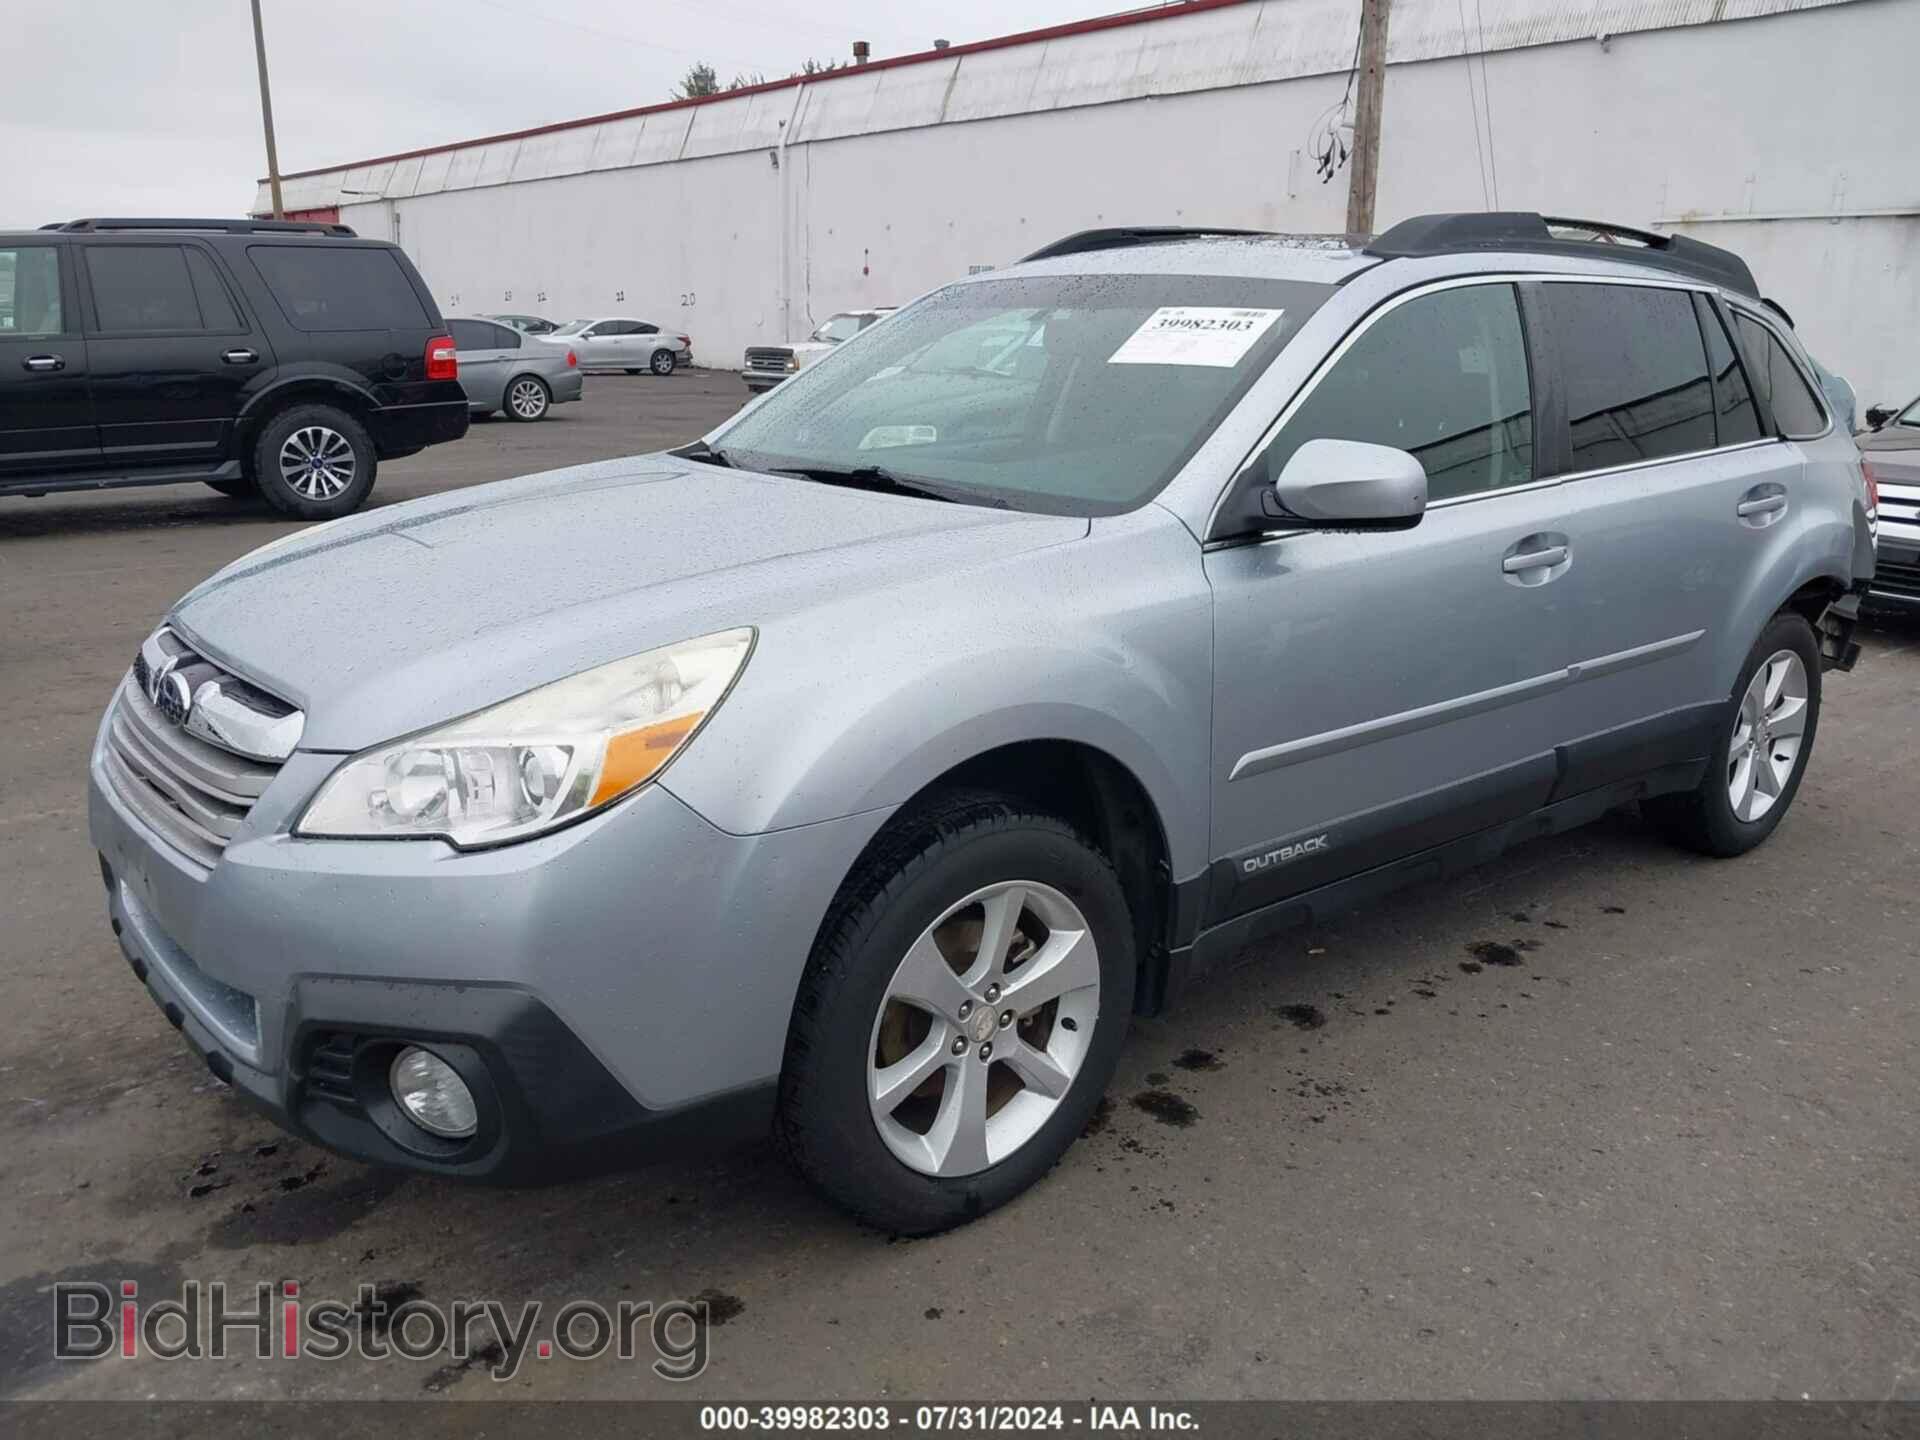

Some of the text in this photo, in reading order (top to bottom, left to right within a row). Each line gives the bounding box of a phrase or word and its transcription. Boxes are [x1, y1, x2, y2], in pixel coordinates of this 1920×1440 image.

[681, 292, 697, 306] 20
[1152, 318, 1255, 332] 39982303
[1243, 833, 1329, 873] OUTBACK
